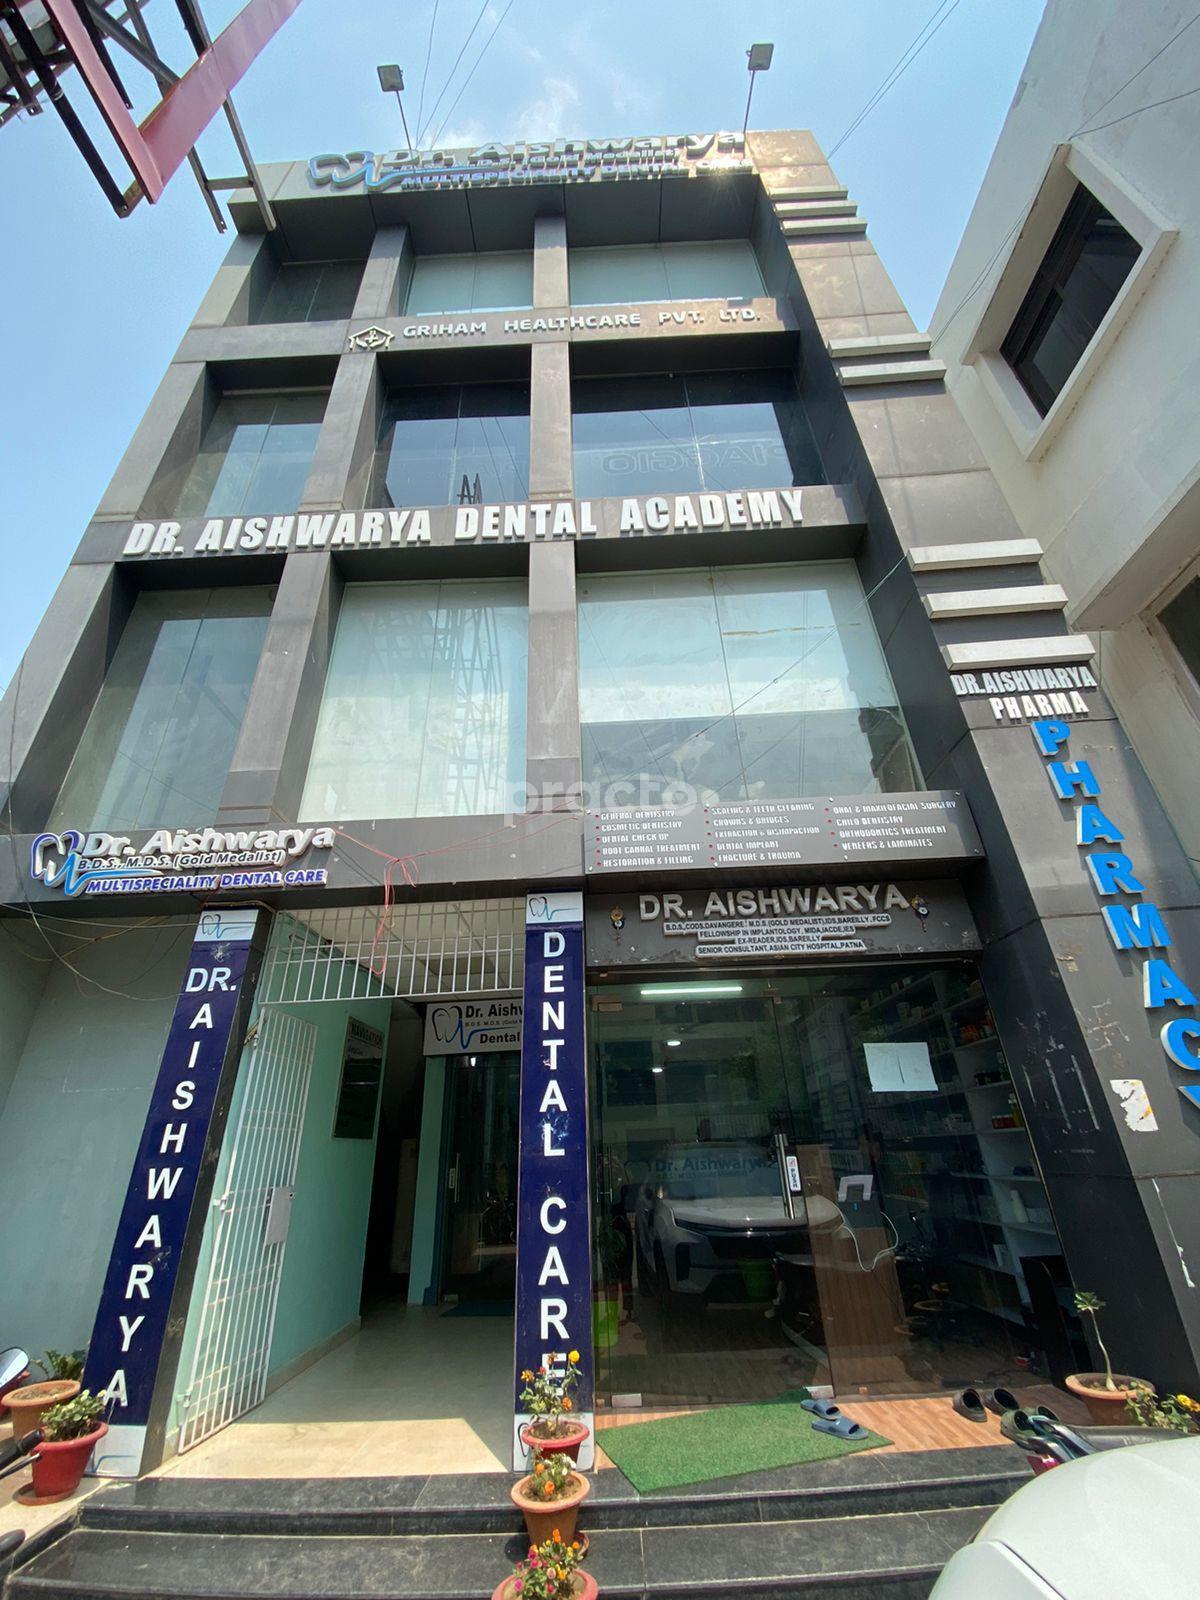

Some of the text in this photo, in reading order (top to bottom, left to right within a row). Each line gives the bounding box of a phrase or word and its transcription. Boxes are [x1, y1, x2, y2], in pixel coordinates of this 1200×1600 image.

[467, 131, 746, 164] Aishwarya
[400, 165, 596, 189] MULTISPECIALITY
[403, 308, 761, 338] GRIHAM HEALTHCARE PVT. LTD.
[122, 488, 807, 556] DR. AISHWARYA DENTAL ACADEMY
[950, 665, 1098, 696] DR.AISHWARYA
[988, 690, 1090, 721] PHARMA
[711, 806, 744, 816] SCALING
[776, 803, 815, 813] CLEANING
[833, 805, 853, 815] ORAL
[920, 800, 957, 810] SURGERY
[600, 810, 675, 821] GENERAL DENTISTRY
[713, 817, 747, 827] CROWNS
[755, 815, 790, 825] BRIDGES
[836, 815, 903, 827] CHILD DENTISTRY
[601, 821, 683, 832] COSMETIC DENTISTRY
[839, 825, 947, 839] ORTHODONTICS TREATMENT
[82, 826, 336, 857] Dr. Aishwarya
[601, 832, 670, 844] DENTAL CHECK UP
[841, 840, 878, 851] VENEERS
[887, 838, 933, 849] LAMINATES
[602, 846, 623, 855] ROOT
[656, 843, 701, 853] TREATMENT
[716, 840, 779, 851] DENTAL IMPLANT
[126, 855, 169, 868] M.D.S.
[174, 853, 214, 869] (Gold
[216, 850, 282, 864] Medalist)
[603, 857, 655, 867] RESTORATION
[664, 855, 694, 865] FILLING
[718, 852, 758, 863] FRACTURE
[767, 851, 801, 861] TRAUMA
[87, 869, 325, 893] MULTISPECIALITY DENTAL CARE
[639, 884, 911, 920] DR. AISHWARYA
[699, 929, 741, 938] FELLOWSHIP
[742, 928, 749, 936] IN
[698, 946, 723, 954] SENIOR
[790, 942, 806, 951] CITY
[465, 1005, 483, 1018] Dr.
[480, 1031, 520, 1044] Dental
[537, 931, 570, 1396] DENTAL CARE
[102, 966, 237, 1407] DR. AISHWARYA
